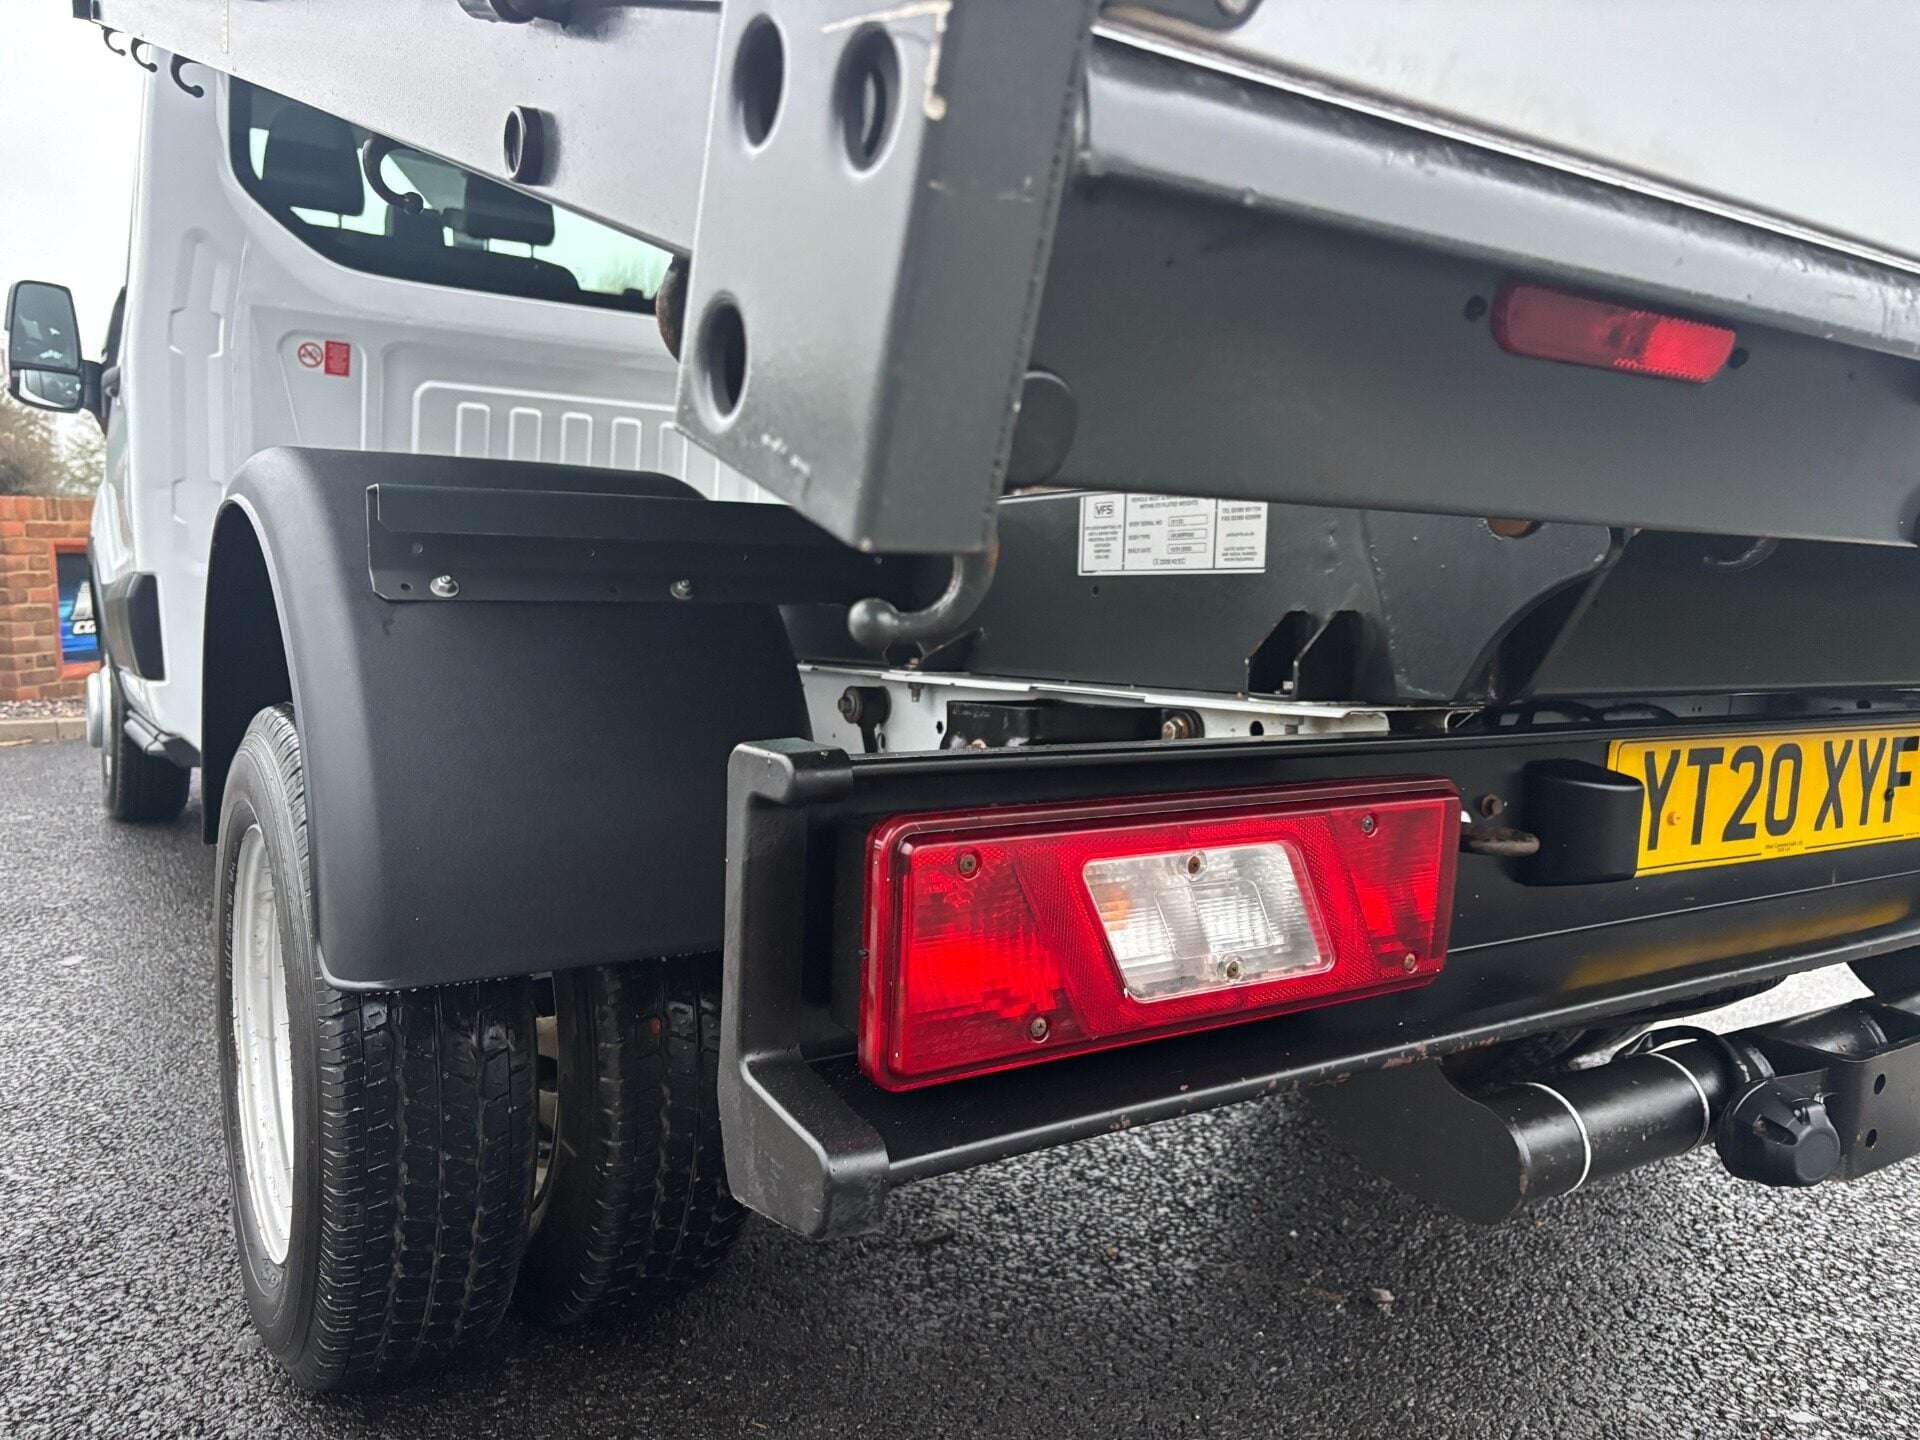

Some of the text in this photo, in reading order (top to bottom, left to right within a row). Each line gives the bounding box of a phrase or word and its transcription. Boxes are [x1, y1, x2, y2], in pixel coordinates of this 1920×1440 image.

[1095, 505, 1113, 515] VFS
[1644, 736, 1920, 851] YT20 XYF
